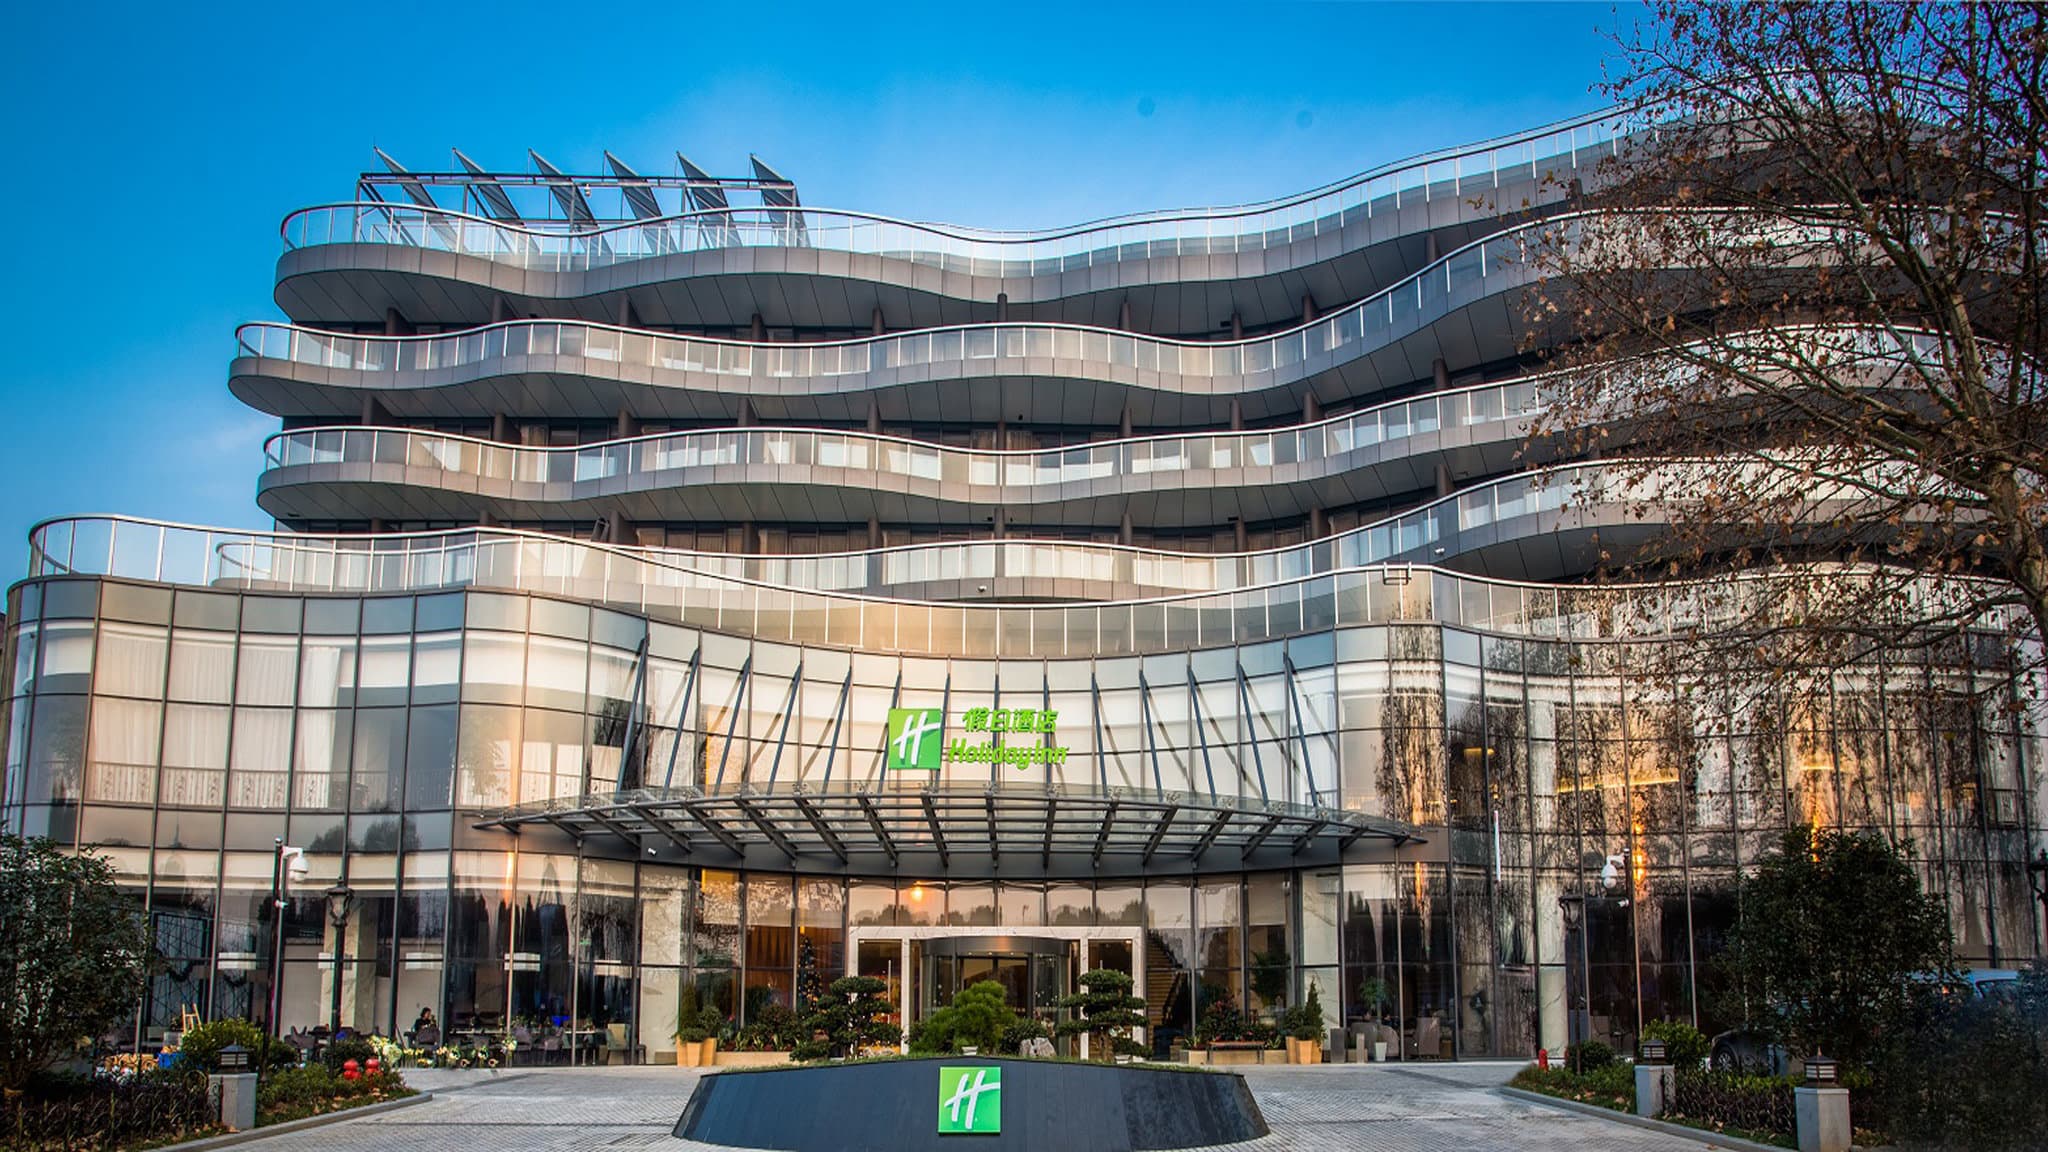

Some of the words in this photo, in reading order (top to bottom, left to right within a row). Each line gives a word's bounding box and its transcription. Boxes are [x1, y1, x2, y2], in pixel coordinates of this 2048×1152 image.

[893, 711, 941, 765] H
[962, 707, 1058, 733] 假日酒店
[948, 738, 1032, 770] Holiday
[1033, 739, 1069, 764] Inn
[944, 1070, 1000, 1129] H
